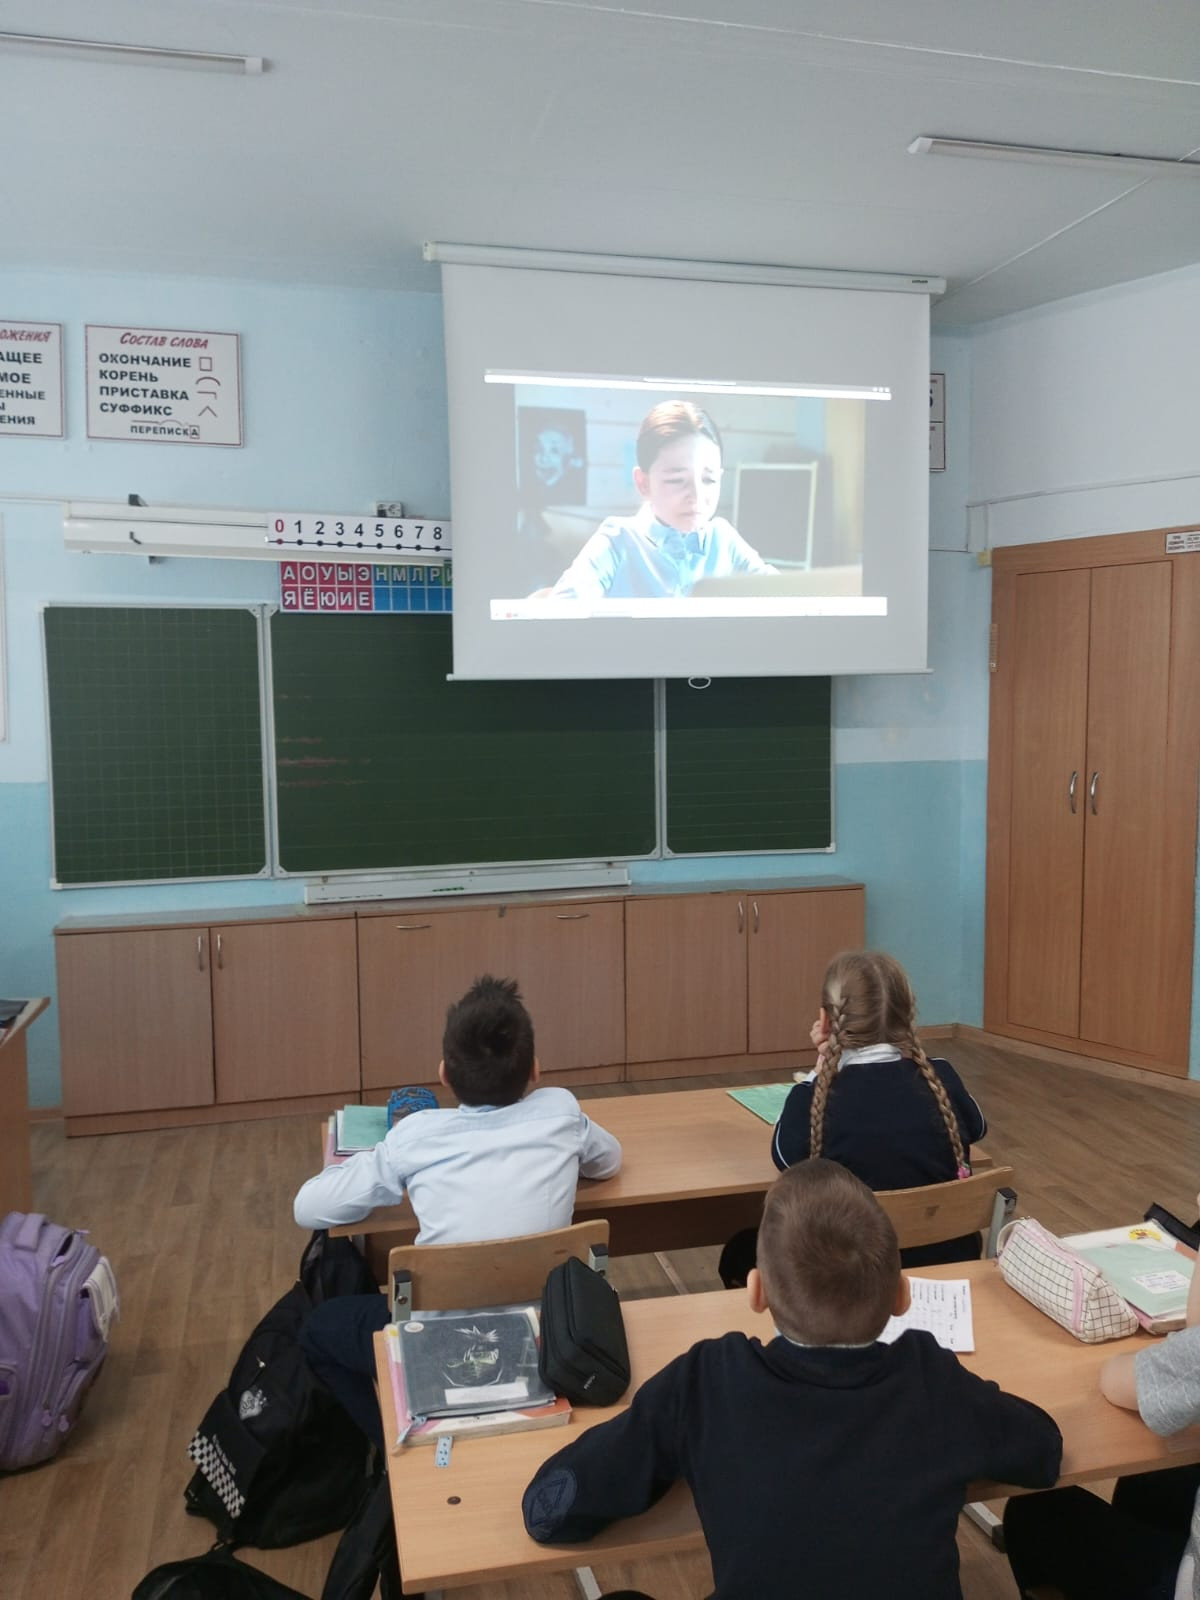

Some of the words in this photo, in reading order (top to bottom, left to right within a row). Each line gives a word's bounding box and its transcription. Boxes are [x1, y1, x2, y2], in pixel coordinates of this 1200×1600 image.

[99, 353, 192, 368] ОКОНЧАНИЕ
[99, 370, 159, 383] КОРЕНЬ
[99, 386, 190, 401] ПРИСТАВКА
[100, 402, 173, 416] СУФФИКС
[130, 425, 199, 438] ПЕРЕПИСКА
[275, 519, 284, 533] 0
[295, 520, 302, 533] 1
[315, 521, 325, 535] 2
[335, 522, 344, 536] 3
[355, 523, 364, 536] 4
[375, 524, 384, 537] 5
[394, 525, 403, 538] 6
[415, 526, 424, 539] 7
[433, 527, 442, 540] 8
